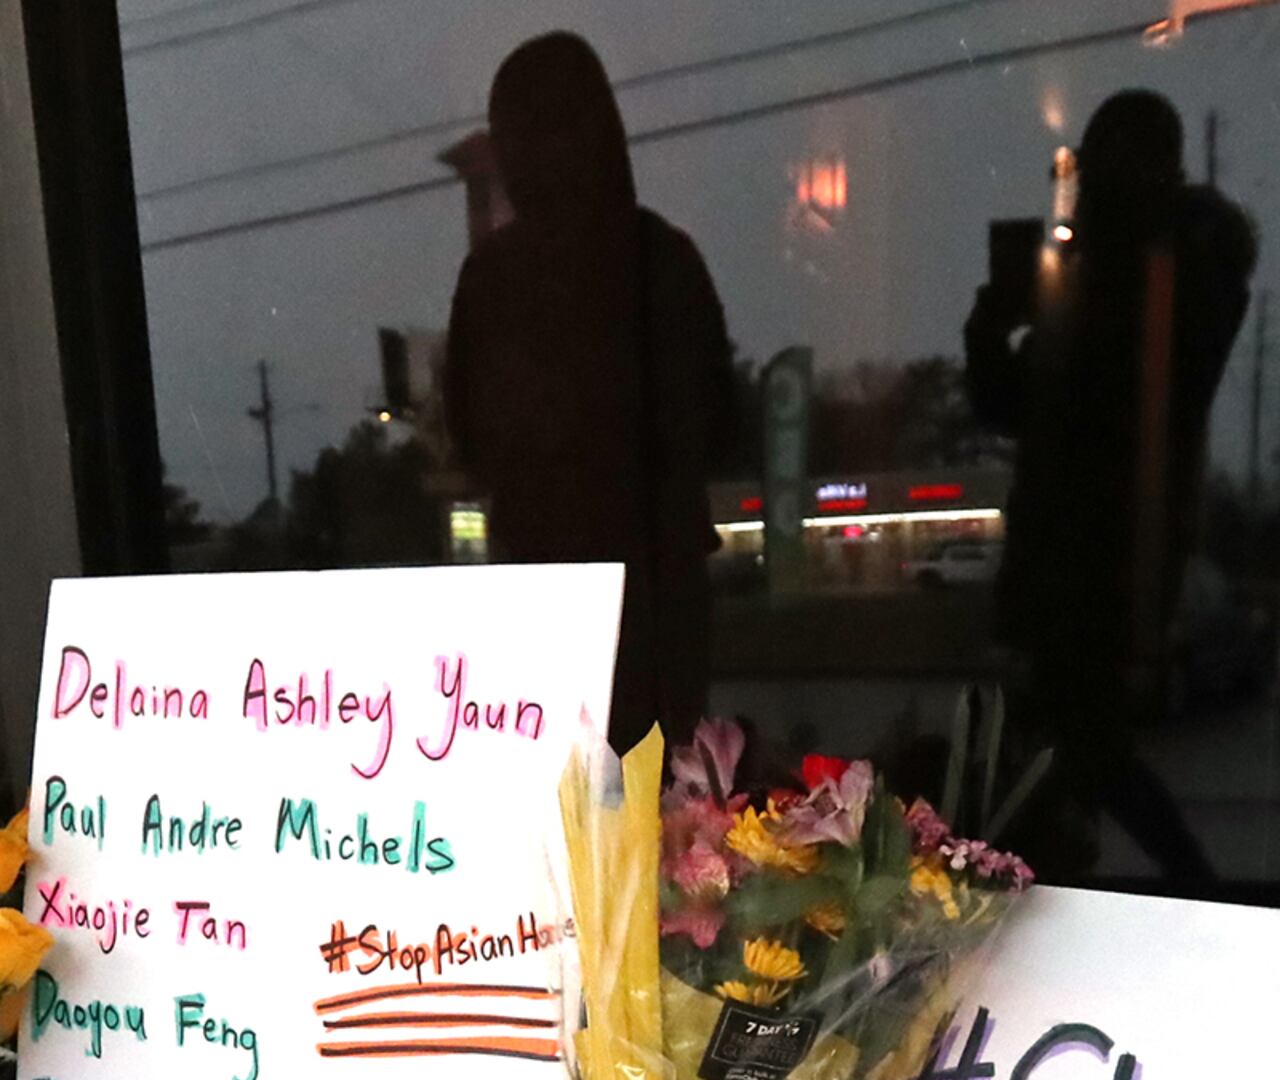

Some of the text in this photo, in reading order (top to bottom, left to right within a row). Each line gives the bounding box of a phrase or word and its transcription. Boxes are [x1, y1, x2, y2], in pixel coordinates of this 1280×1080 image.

[51, 645, 546, 779] Delaina Ashley Yaun
[42, 775, 456, 874] Paul Andre Michels
[37, 880, 248, 954] Xiaojie Tan
[319, 911, 577, 983] #StopAsianHae
[31, 970, 149, 1059] Daoyou
[745, 1021, 757, 1034] 7
